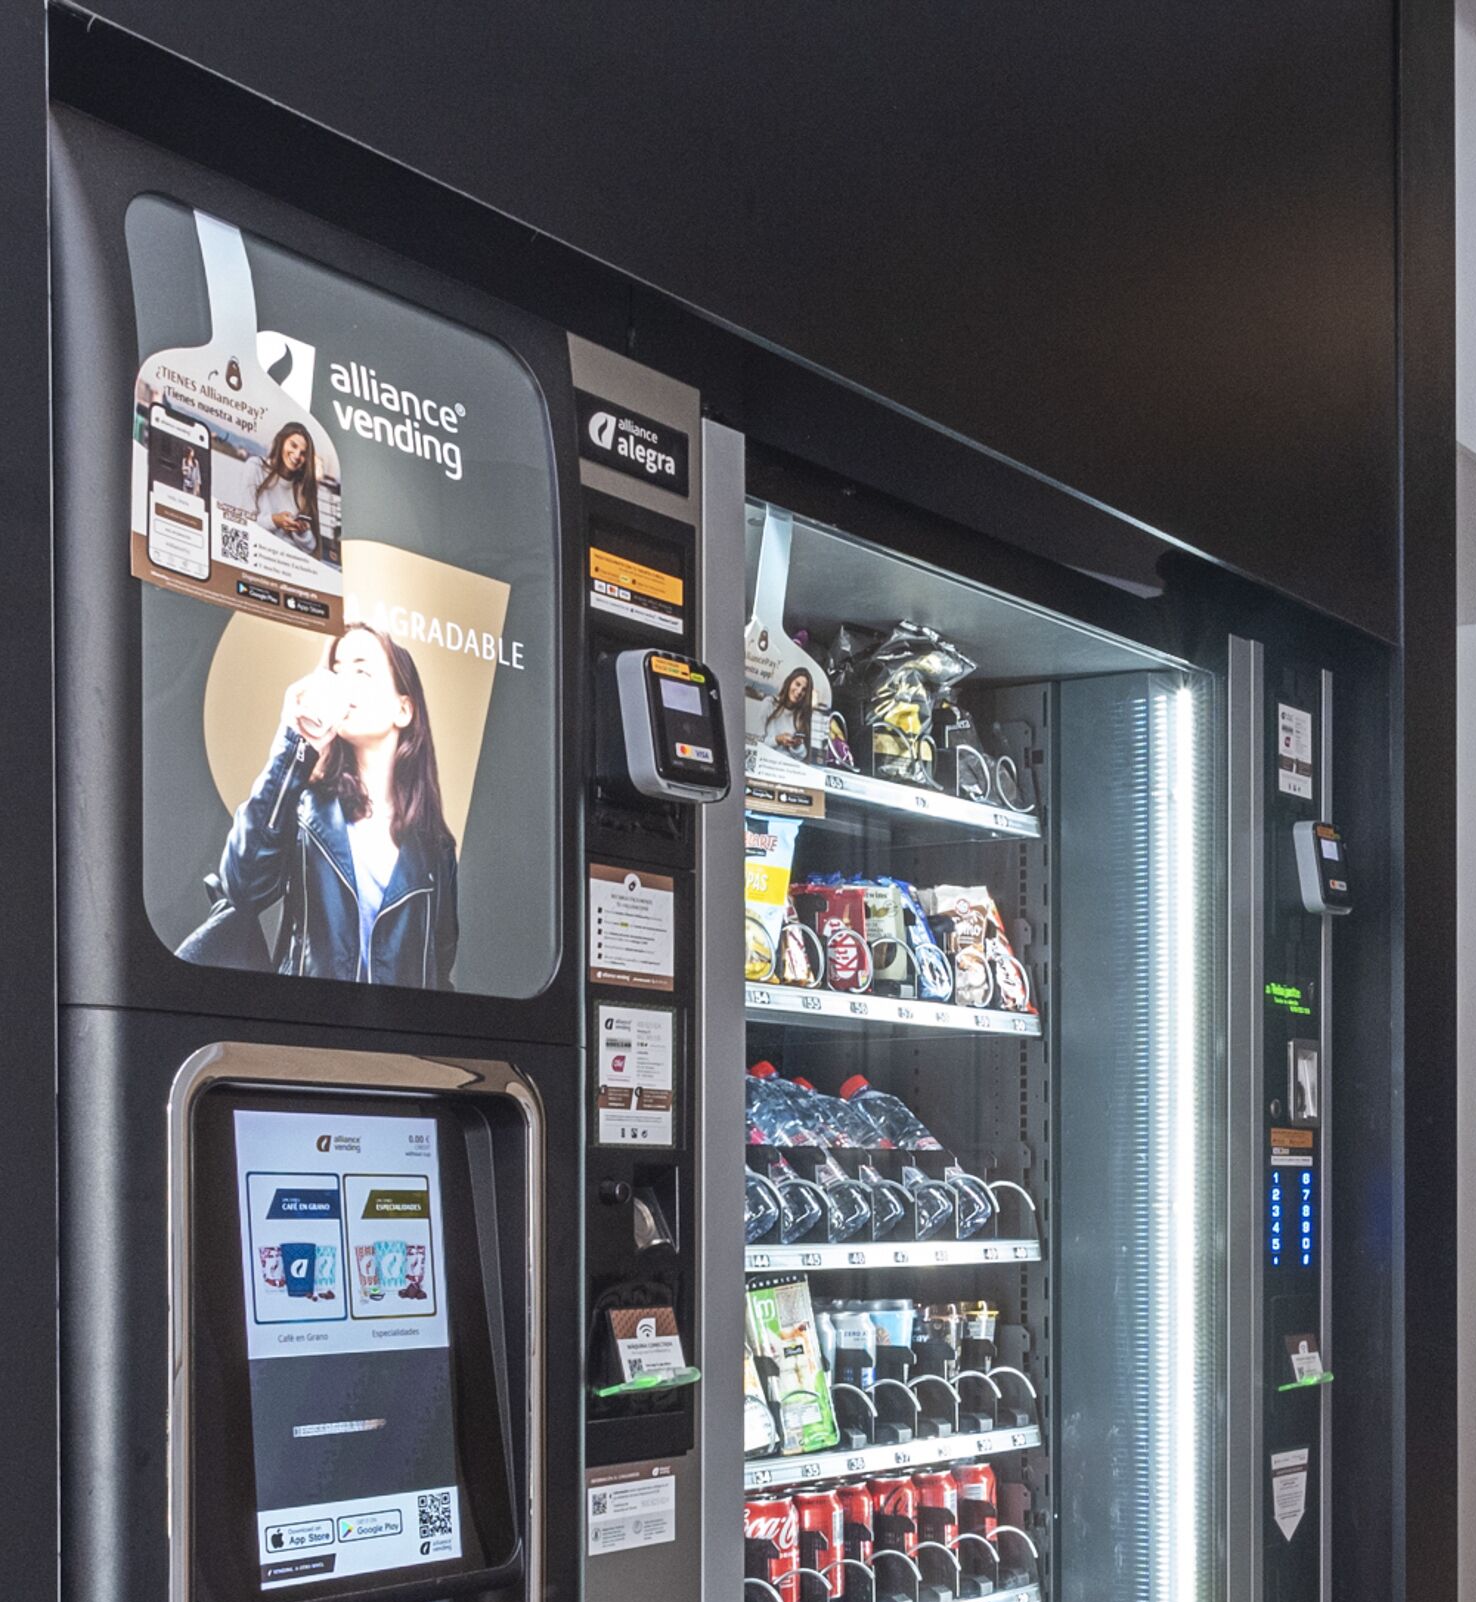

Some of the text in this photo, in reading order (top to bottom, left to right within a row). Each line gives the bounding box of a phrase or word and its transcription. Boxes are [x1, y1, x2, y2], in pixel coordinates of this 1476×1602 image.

[198, 402, 233, 422] nuestra
[618, 418, 658, 444] alliance
[333, 400, 463, 481] vending
[617, 435, 676, 475] alegra
[695, 750, 709, 760] VISA
[334, 1135, 361, 1143] alliance
[334, 1144, 361, 1154] vending
[1272, 1172, 1279, 1183] 1
[1272, 1189, 1310, 1201] 2 7
[1272, 1205, 1310, 1217] 3 8
[1272, 1221, 1280, 1233] 4
[1272, 1238, 1310, 1250] 5 0
[278, 1332, 294, 1343] Café
[306, 1332, 329, 1342] Grano
[372, 1328, 420, 1339] Especialidades
[357, 1522, 399, 1536] Google Play
[289, 1532, 330, 1546] App Store
